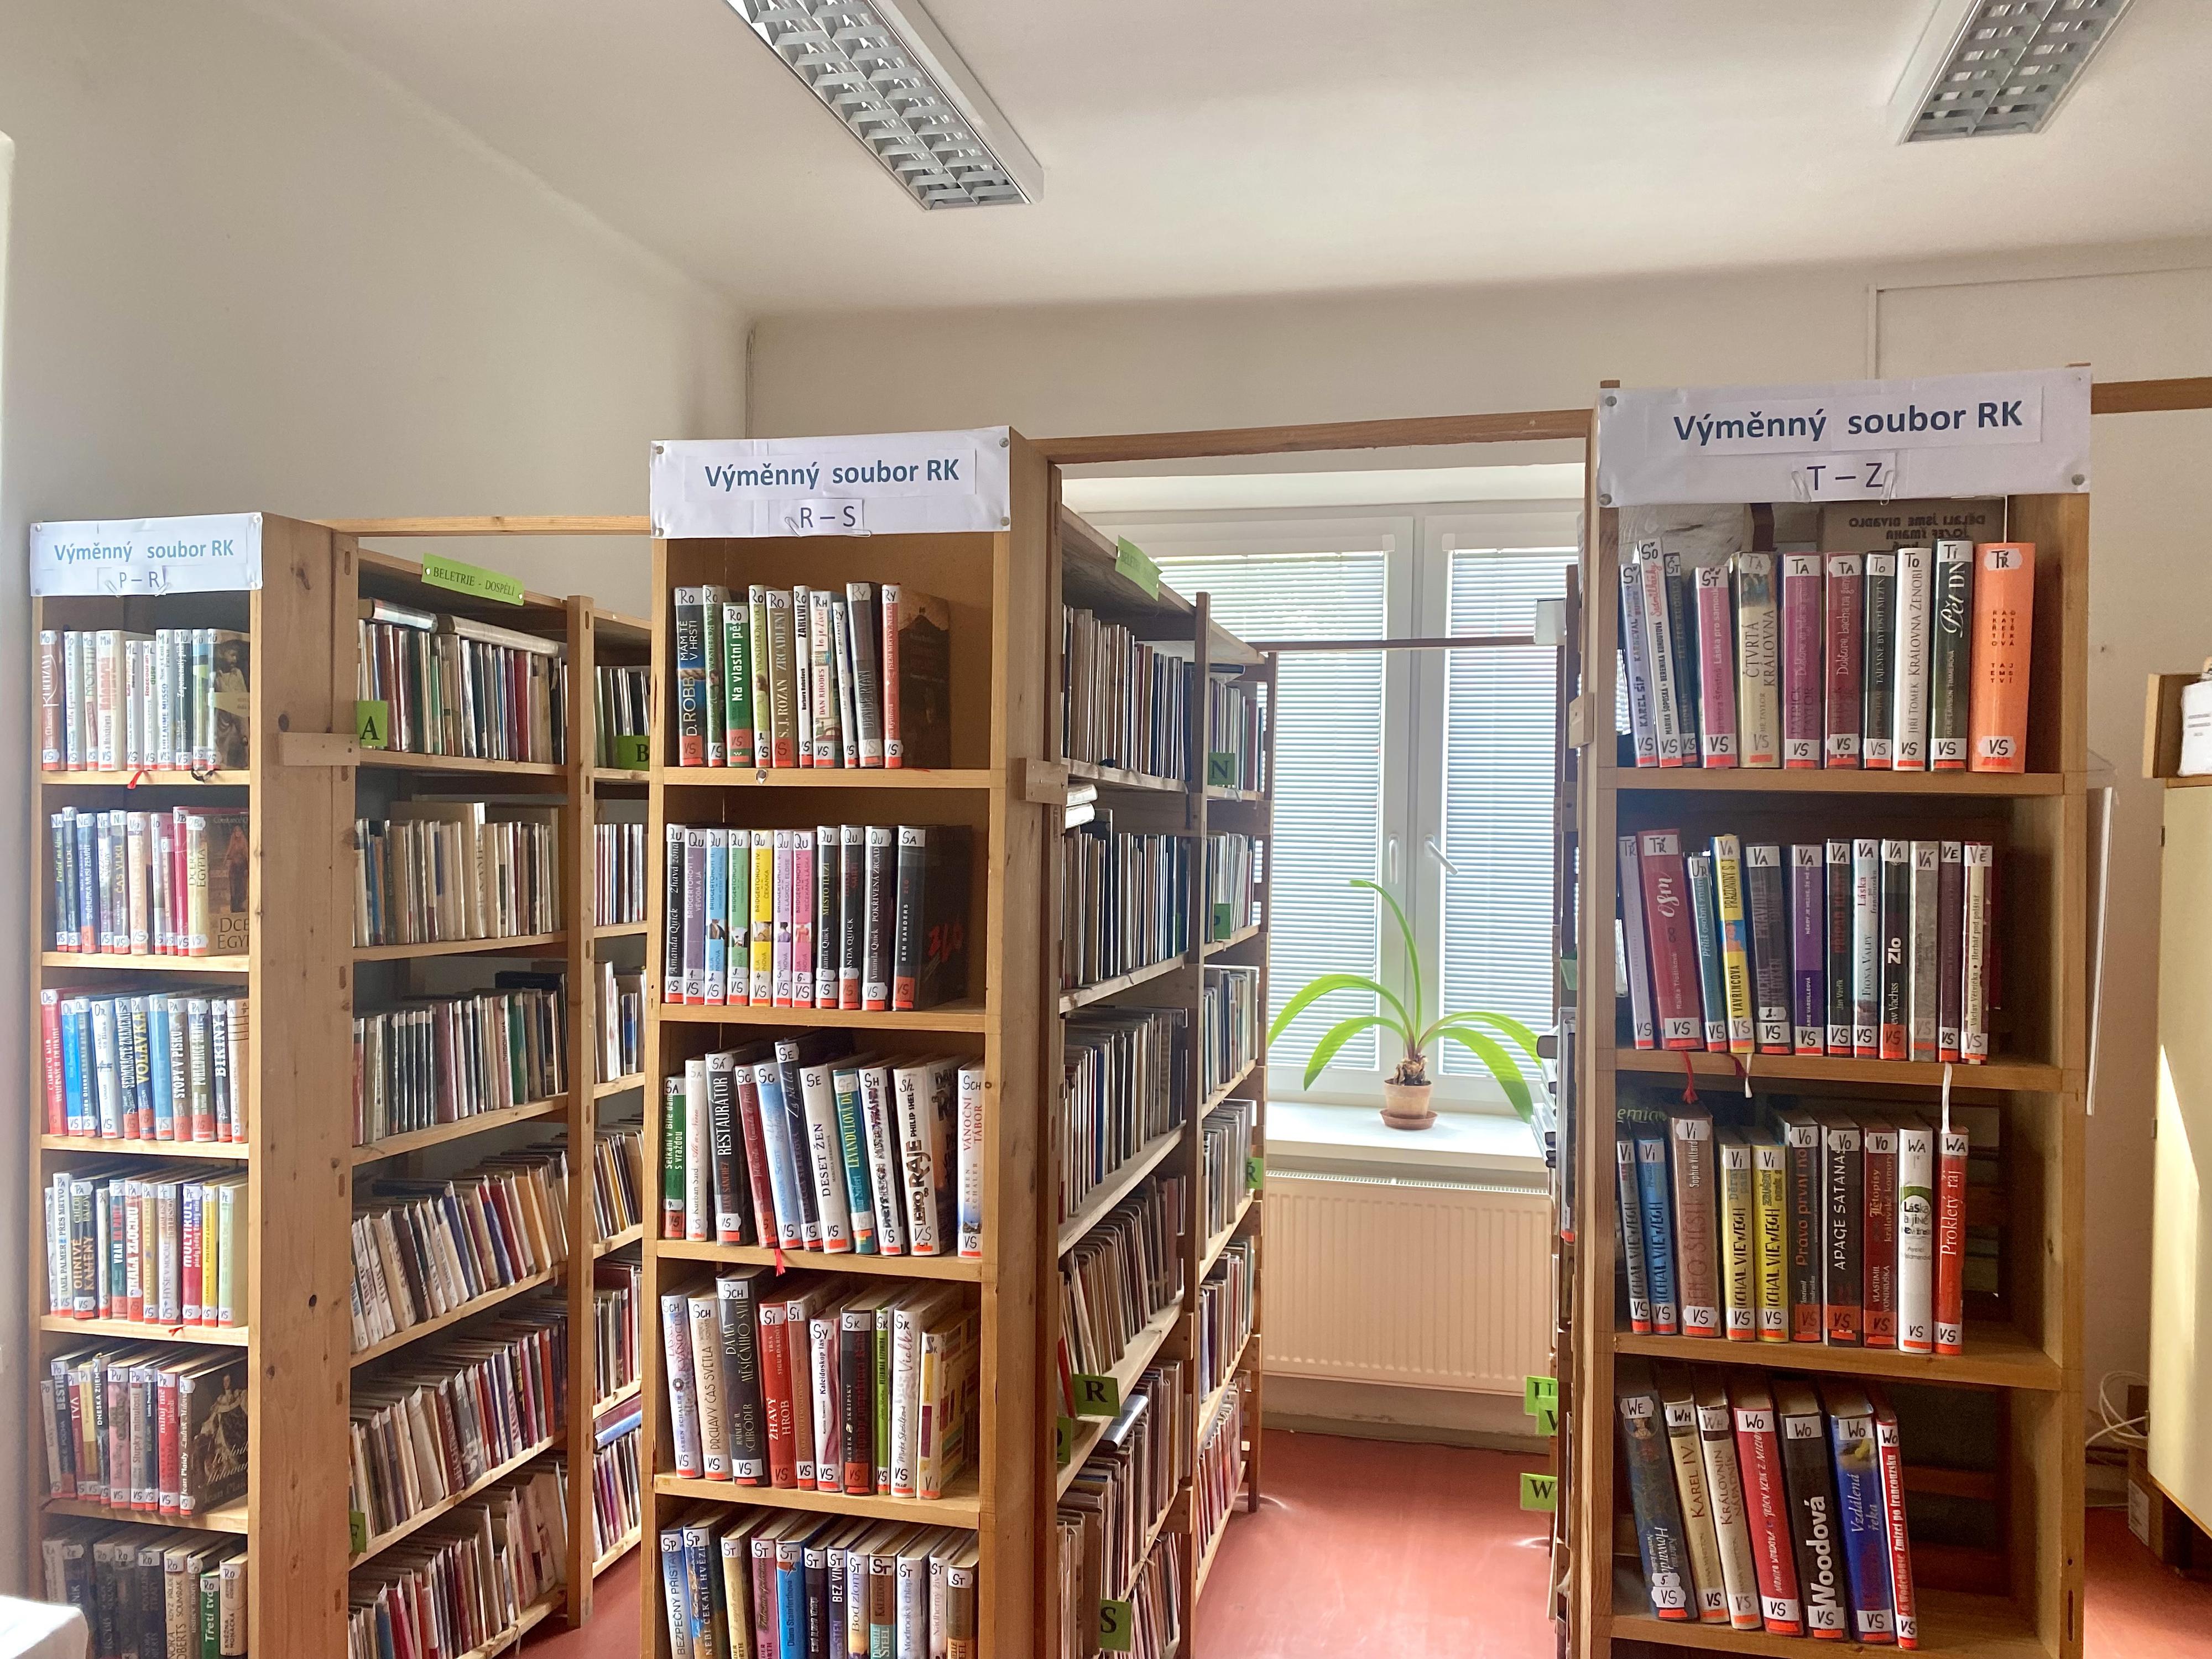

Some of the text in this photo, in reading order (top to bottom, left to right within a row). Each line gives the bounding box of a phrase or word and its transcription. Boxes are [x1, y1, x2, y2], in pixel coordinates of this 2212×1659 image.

[1673, 400, 2023, 446] Výměnný soubor RK
[705, 458, 959, 492] Výměnný soubor RK
[1807, 466, 1826, 491] T
[1865, 462, 1883, 487] Z
[800, 507, 813, 528] R
[843, 505, 856, 527] S
[54, 540, 233, 564] Výměnný soubor RK
[1792, 559, 1809, 574] TA
[1839, 562, 1854, 574] TA
[119, 572, 127, 588] P
[149, 571, 159, 588] R
[434, 567, 475, 586] BELETRIE
[485, 580, 515, 596] DOSPĚLÍ
[678, 636, 688, 661] MÁM
[1743, 622, 1760, 678] ČTVRTÁ
[1762, 610, 1776, 686] KRÁLOVNA
[731, 643, 742, 701] Na vlastní
[774, 612, 788, 716] ROZAN ZRCADLENÍ
[1908, 615, 1922, 713] TOMEK KRÁLOVNA
[683, 677, 696, 722] ROBB
[1638, 695, 1648, 727] KAREL
[361, 716, 380, 740] A
[732, 736, 743, 747] VS
[817, 745, 829, 756] VS
[1710, 737, 1729, 753] VS
[1793, 743, 1809, 755] VS
[1837, 738, 1851, 750] VS
[146, 754, 155, 763] VS
[637, 744, 649, 762] B
[1211, 760, 1229, 780] N
[902, 831, 916, 844] SA
[1799, 849, 1813, 865] VA
[1859, 843, 1874, 858] VA
[1944, 847, 1958, 859] VE
[196, 849, 206, 887] EGYPTA
[1858, 877, 1867, 906] Láska
[179, 938, 189, 947] VS
[669, 909, 680, 973] Amanda Quick
[870, 929, 879, 950] Quick
[1887, 937, 1902, 1010] Vachss Zlo
[686, 982, 699, 995] VS
[731, 980, 743, 993] VS
[796, 985, 810, 998] VS
[1674, 1022, 1691, 1035] VS
[1766, 1025, 1781, 1040] VS
[1802, 1031, 1816, 1046] VS
[212, 1018, 226, 1077] BIKINY
[173, 1070, 185, 1098] STOPY
[807, 1074, 821, 1087] SE
[70, 1119, 79, 1129] VS
[712, 1077, 732, 1155] RESTAURÁTOR
[908, 1112, 917, 1138] PHILIP
[963, 1097, 972, 1151] VÁNOČNÍ
[973, 1105, 982, 1143] TÁBOR
[842, 1107, 859, 1168] LEVANDULOVÁ
[1908, 1140, 1926, 1153] WA
[1946, 1138, 1965, 1152] WA
[813, 1123, 831, 1197] DESET ŽEN
[1687, 1140, 1699, 1163] Villard
[1689, 1165, 1700, 1188] Sophie
[1940, 1170, 1963, 1256] Prokletý ráj
[828, 1225, 839, 1237] VS
[914, 1227, 932, 1241] VS
[1648, 1202, 1666, 1258] VIEWEGH
[1733, 1208, 1746, 1266] VIEWEGH
[1765, 1208, 1780, 1266] VIEWEGH
[964, 1236, 977, 1249] VS
[1795, 1220, 1809, 1266] Právo
[1834, 1220, 1847, 1270] APAGE
[82, 1236, 94, 1291] KAMENY
[113, 1243, 123, 1264] VRAH
[79, 1300, 88, 1309] VS
[1634, 1301, 1648, 1317] VS
[1693, 1310, 1708, 1325] VS
[722, 1323, 736, 1355] DÁMA
[1910, 1326, 1924, 1338] VS
[1940, 1328, 1956, 1342] VS
[704, 1384, 716, 1404] ČAS
[1084, 1380, 1108, 1404] R
[780, 1400, 791, 1434] HROB
[708, 1458, 720, 1470] VS
[739, 1463, 751, 1475] VS
[821, 1468, 833, 1480] VS
[1530, 1479, 1554, 1500] W
[1681, 1442, 1704, 1518] KAREL IV.
[113, 1491, 123, 1500] VS
[1847, 1474, 1865, 1532] Vzdálená
[686, 1531, 700, 1546] SP
[755, 1543, 769, 1557] ST
[830, 1553, 843, 1566] ST
[1805, 1496, 1836, 1608] Woodová
[873, 1559, 891, 1574] ST
[952, 1573, 966, 1585] ST
[832, 1585, 842, 1603] BEZ
[1661, 1590, 1677, 1604] VS
[1707, 1593, 1721, 1606] VS
[851, 1606, 860, 1631] Bod
[1770, 1602, 1786, 1615] VS
[672, 1598, 686, 1655] BEZPEČNÝ
[1100, 1606, 1117, 1634] S
[880, 1627, 890, 1656] STEEL
